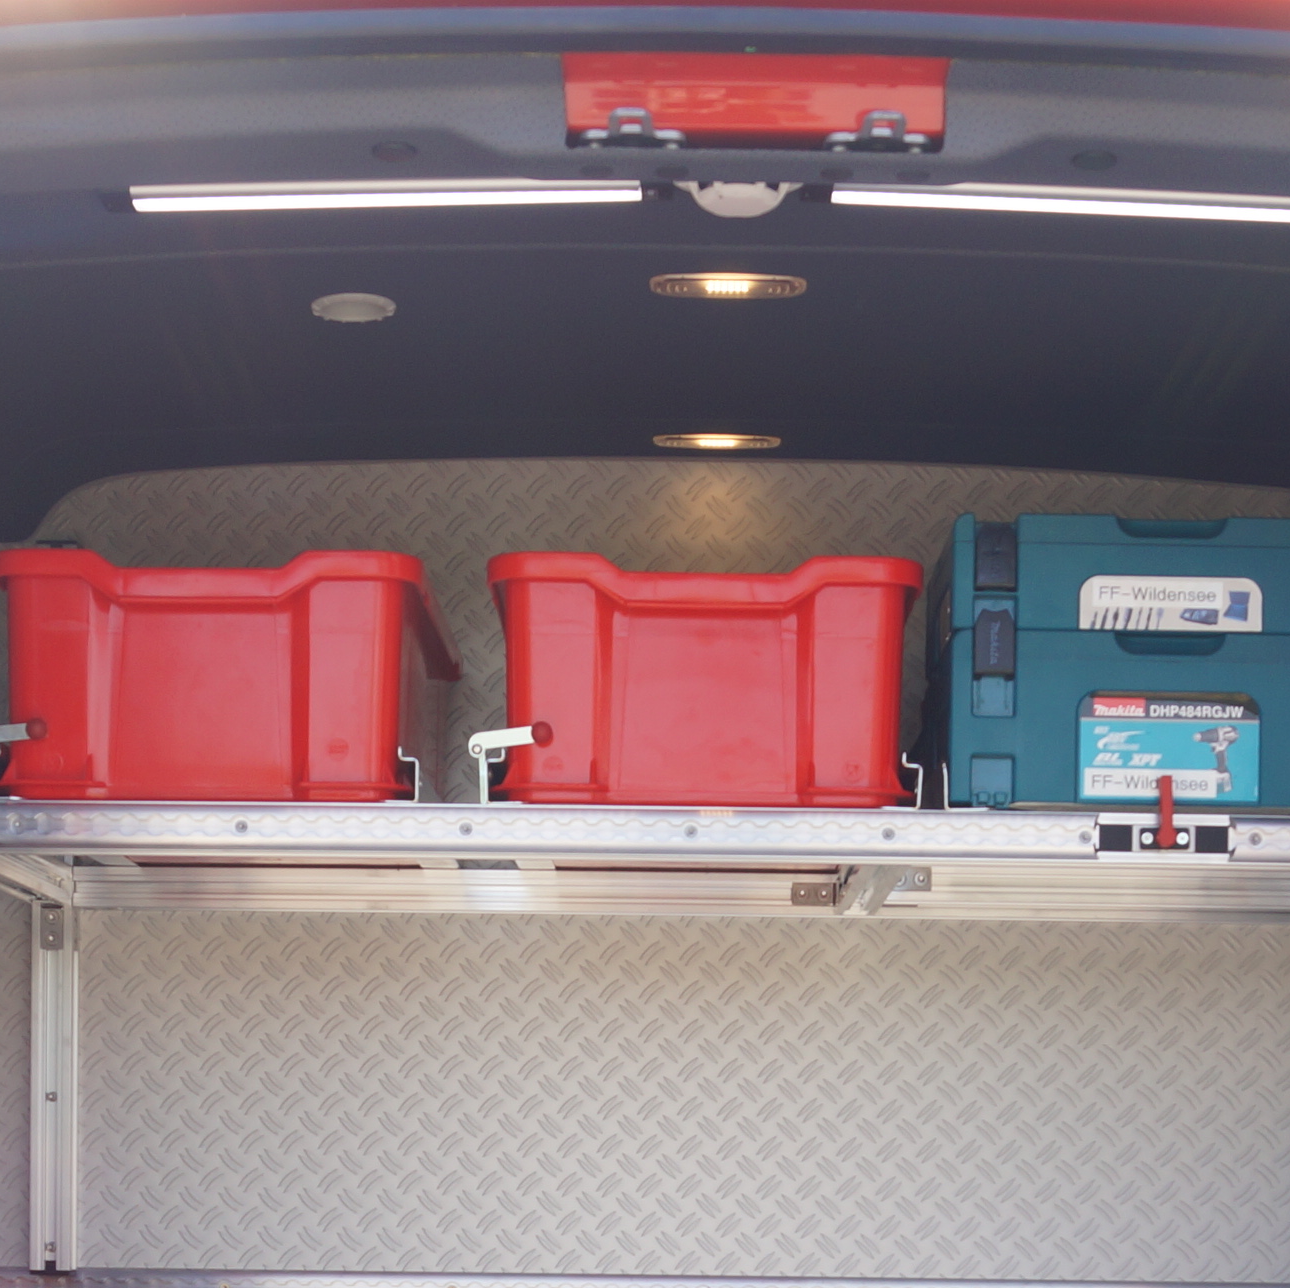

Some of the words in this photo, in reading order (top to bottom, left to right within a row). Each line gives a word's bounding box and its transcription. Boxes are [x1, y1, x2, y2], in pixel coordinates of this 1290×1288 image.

[1098, 585, 1217, 601] FF-Wildensee
[1149, 705, 1244, 719] DHP484RGJW
[1091, 774, 1209, 791] FF-Wildnsee
